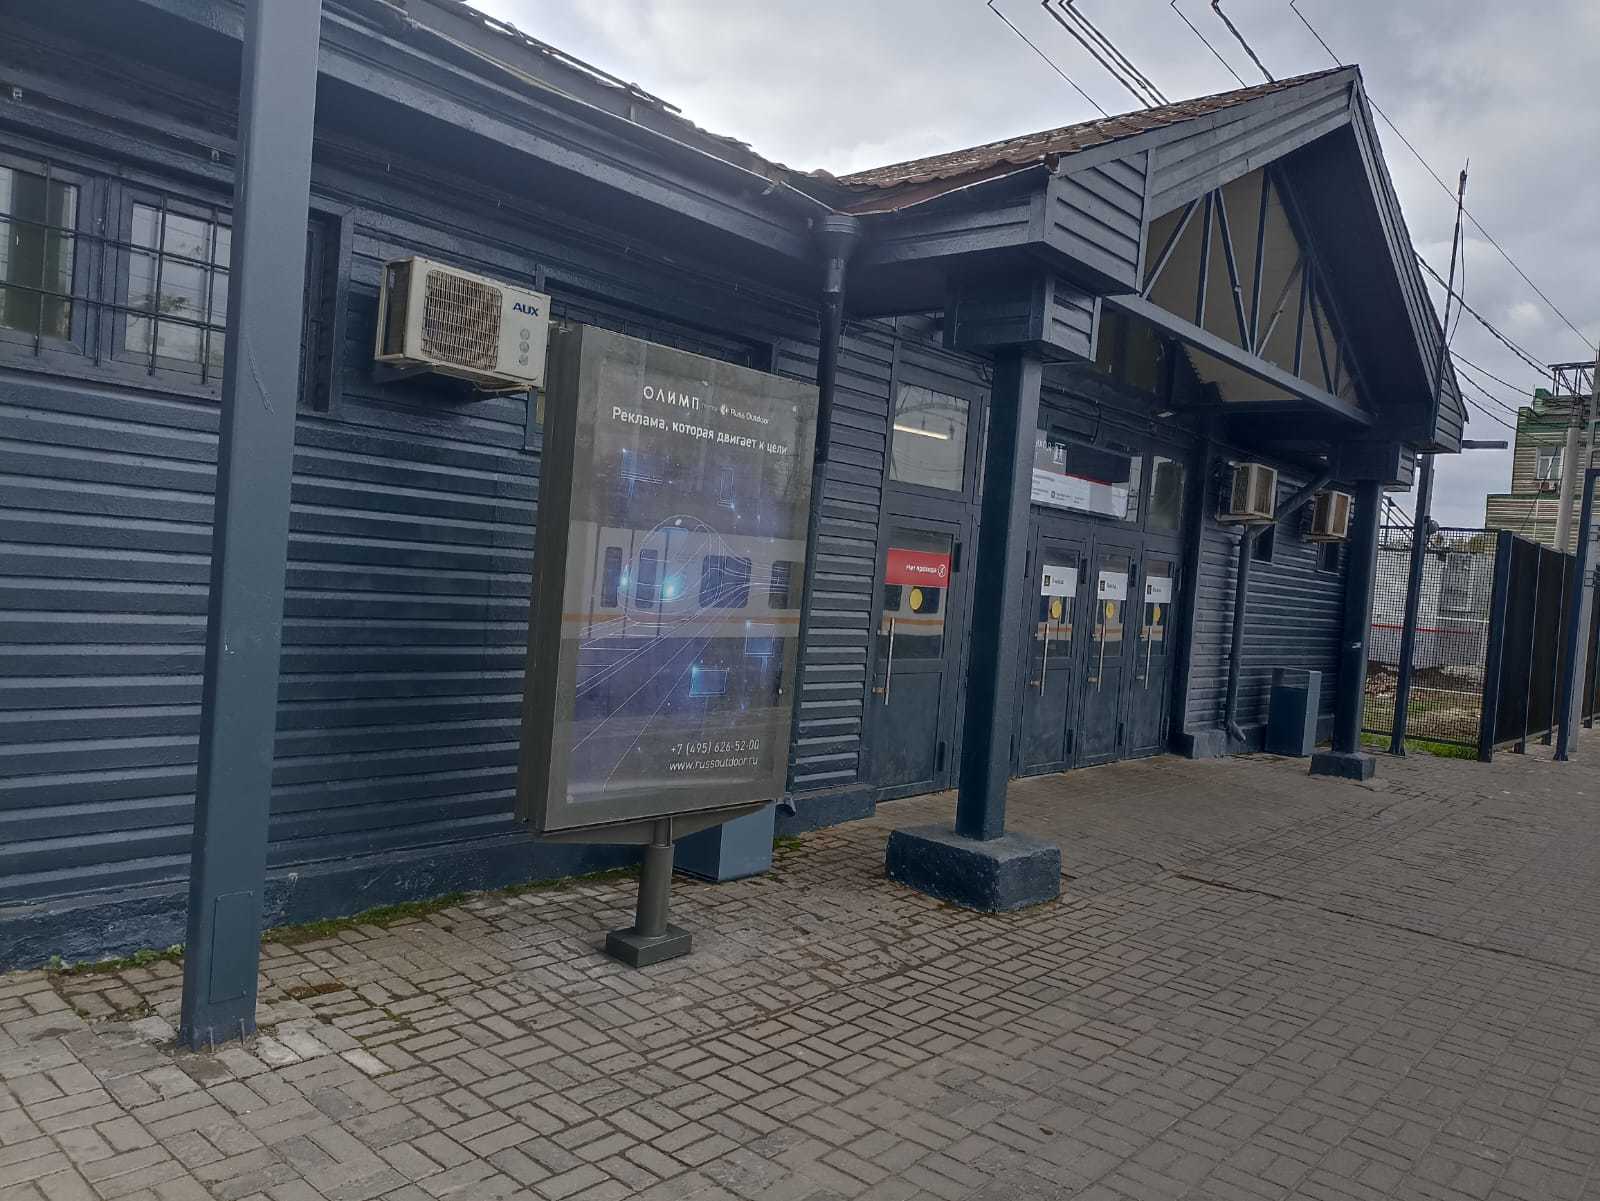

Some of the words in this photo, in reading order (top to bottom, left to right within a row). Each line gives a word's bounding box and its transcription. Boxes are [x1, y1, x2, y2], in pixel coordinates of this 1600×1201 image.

[513, 302, 539, 317] AUX
[643, 386, 700, 411] ОЛИМП
[612, 406, 669, 432] Реклама,
[672, 420, 715, 441] которая
[716, 431, 757, 449] двигает
[766, 442, 788, 456] цели
[671, 743, 683, 755] +7
[686, 742, 712, 756] (495)
[669, 756, 758, 771] www.russoutdoor.ru
